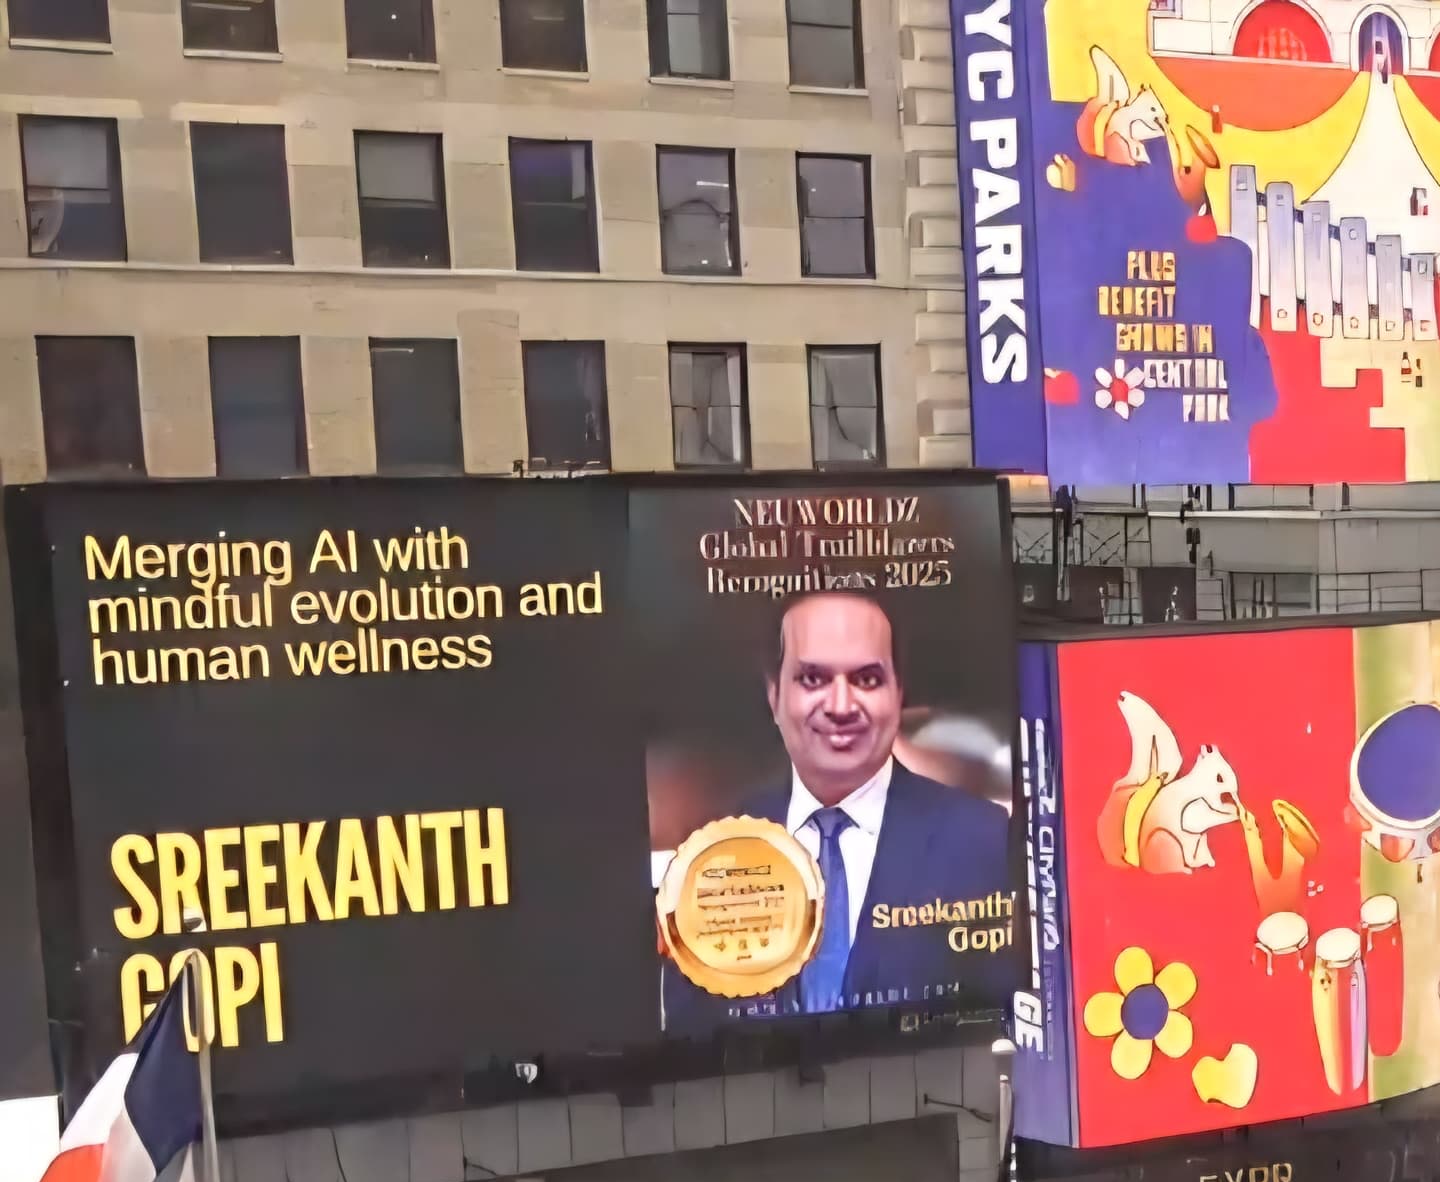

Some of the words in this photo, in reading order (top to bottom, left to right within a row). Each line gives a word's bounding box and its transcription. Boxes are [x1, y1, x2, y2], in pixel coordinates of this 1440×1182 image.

[970, 117, 1028, 385] PARKS
[85, 531, 291, 586] Merging
[310, 528, 360, 574] AI
[372, 525, 469, 570] with
[884, 559, 952, 589] 2025
[87, 579, 273, 633] mindful
[291, 574, 508, 625] evolution
[520, 571, 603, 617] and
[92, 628, 270, 686] human
[286, 626, 494, 677] wellness
[111, 807, 509, 939] SREEKANTH
[120, 942, 283, 1053] GOPI
